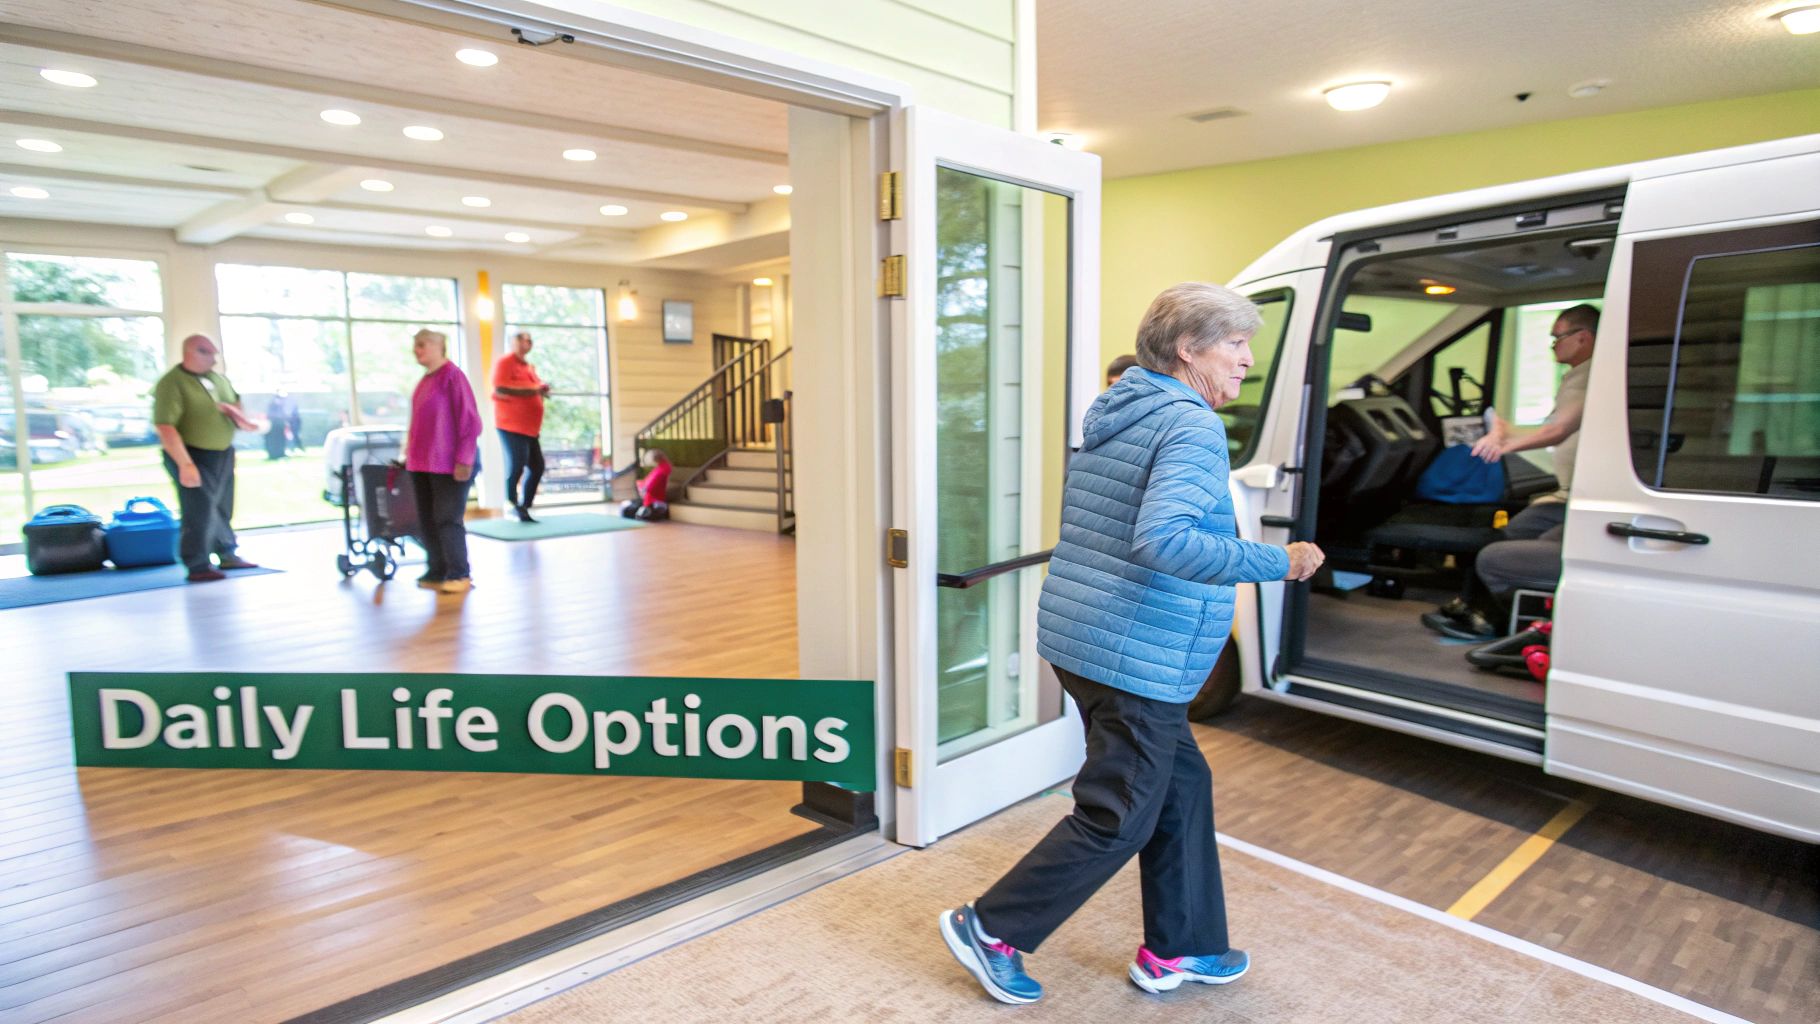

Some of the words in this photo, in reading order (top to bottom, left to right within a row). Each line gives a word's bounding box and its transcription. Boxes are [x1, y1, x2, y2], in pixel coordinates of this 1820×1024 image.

[99, 686, 314, 760] Daily
[341, 687, 499, 752] Life
[527, 692, 849, 769] Options
